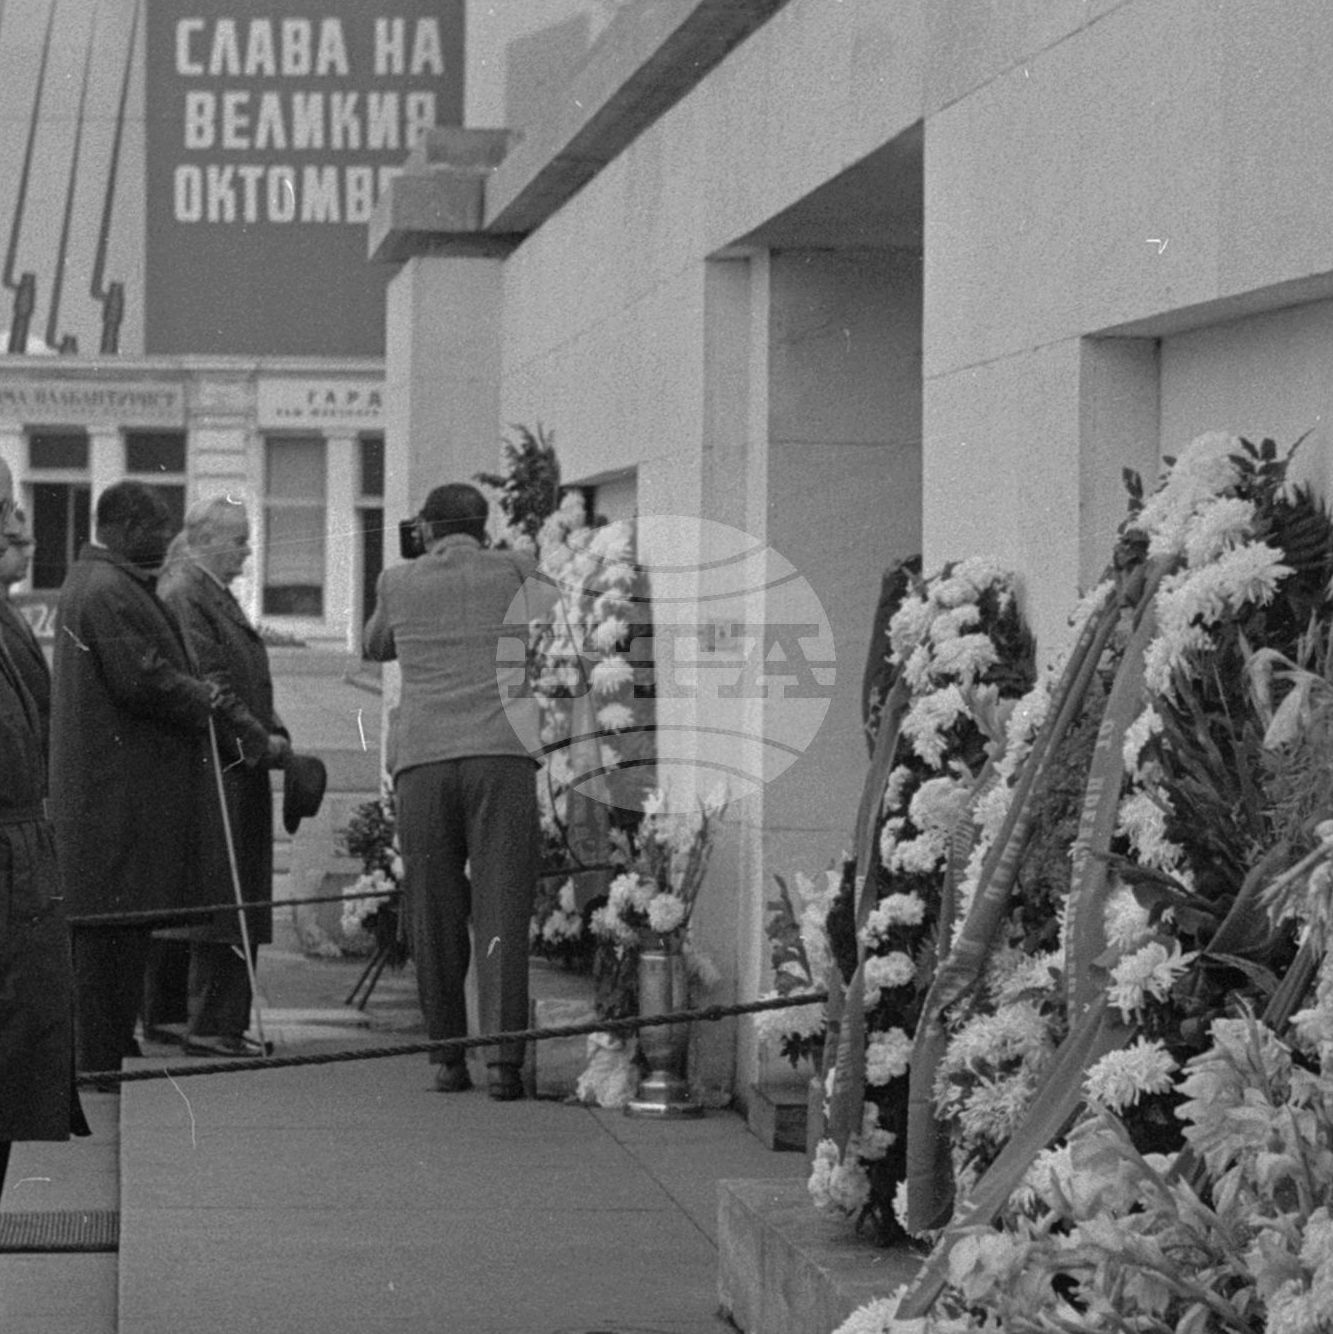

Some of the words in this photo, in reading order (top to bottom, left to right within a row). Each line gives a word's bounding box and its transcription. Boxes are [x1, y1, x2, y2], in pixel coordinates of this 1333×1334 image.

[175, 17, 350, 76] СЛАВА
[374, 17, 445, 76] НА
[184, 91, 437, 150] ВЕЛИКИЯ
